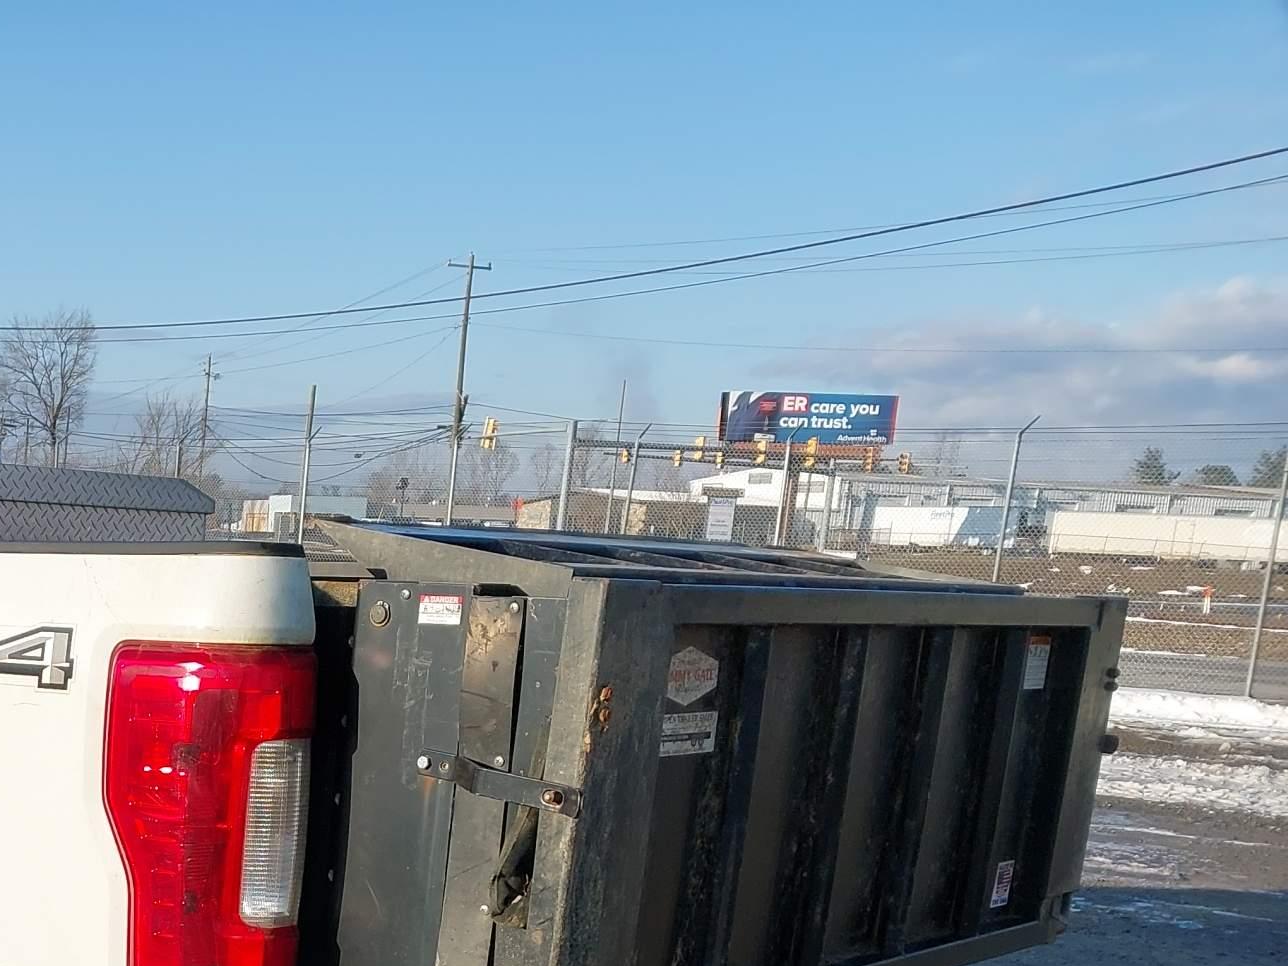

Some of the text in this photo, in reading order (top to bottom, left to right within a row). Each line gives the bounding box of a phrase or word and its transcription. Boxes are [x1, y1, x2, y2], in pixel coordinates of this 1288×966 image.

[782, 396, 807, 412] ER
[810, 401, 845, 414] care
[850, 403, 880, 417] you
[779, 416, 852, 429] can trust.
